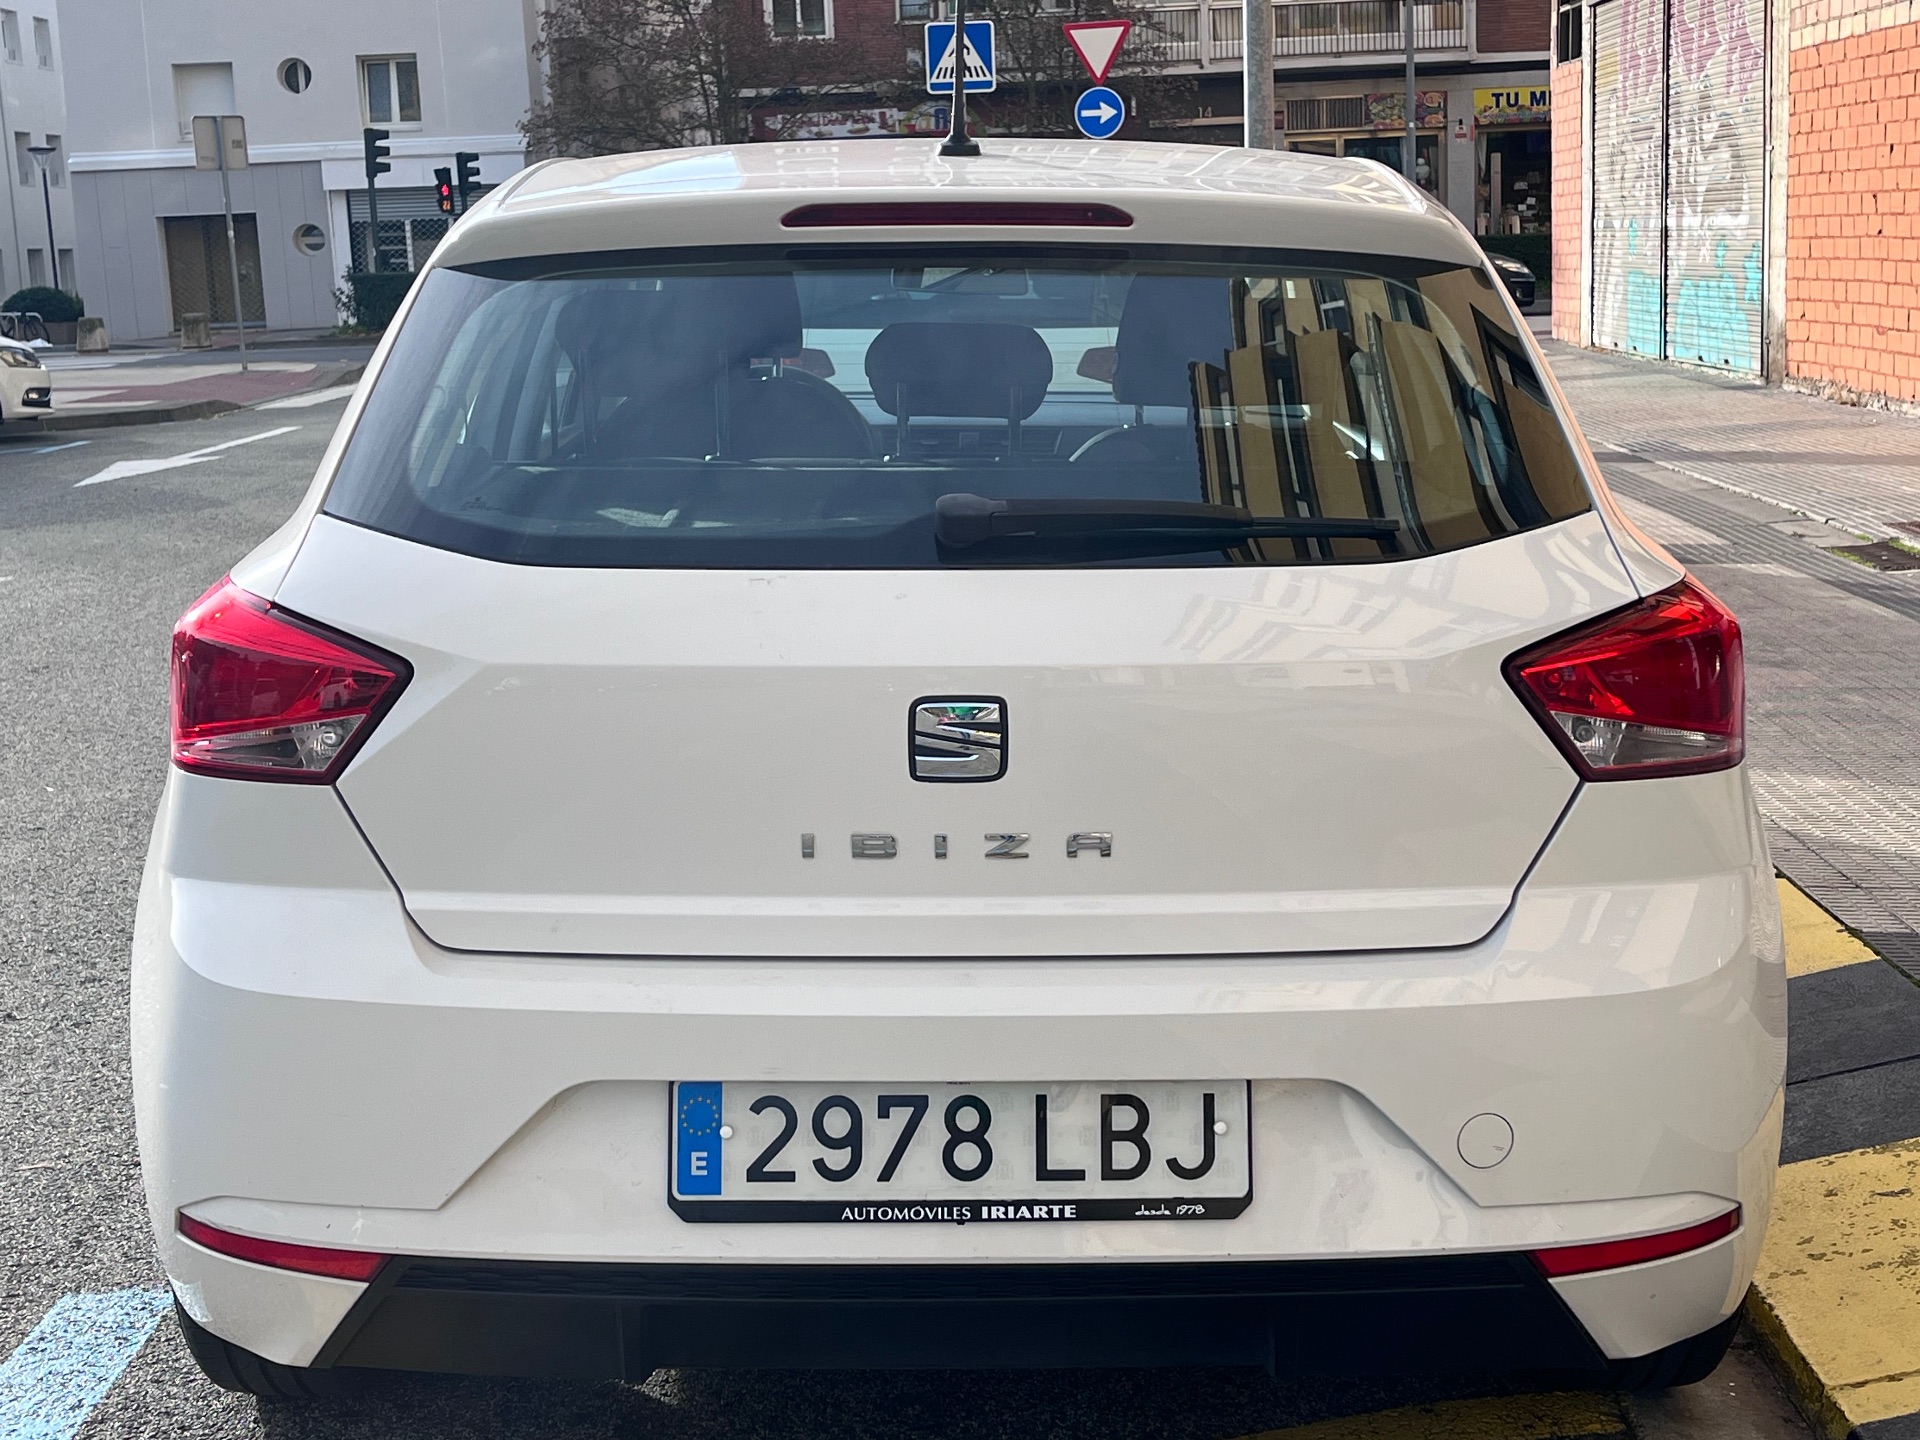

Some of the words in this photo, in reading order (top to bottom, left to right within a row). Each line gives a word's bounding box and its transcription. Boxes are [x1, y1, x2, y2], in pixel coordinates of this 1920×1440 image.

[1491, 91, 1519, 108] TU
[1198, 106, 1212, 118] 14
[801, 831, 1113, 859] IBIZA
[746, 1094, 993, 1182] 2978
[1035, 1093, 1216, 1181] LBJ
[690, 1151, 708, 1176] E
[841, 1205, 971, 1220] AUTOMÓVILES
[981, 1205, 1077, 1219] IRIARTE
[1135, 1203, 1171, 1215] desde
[1176, 1204, 1205, 1215] 1978
